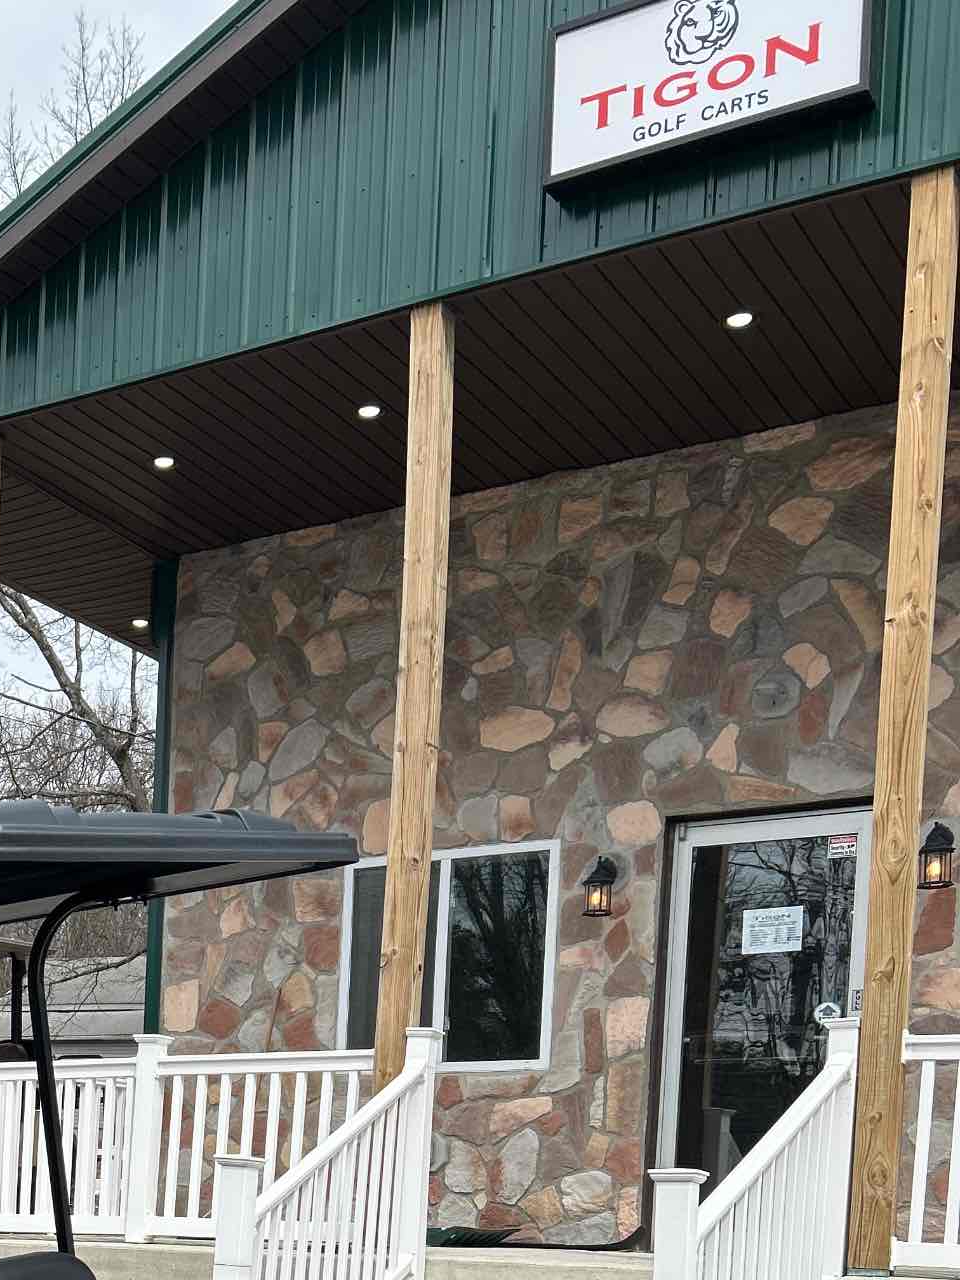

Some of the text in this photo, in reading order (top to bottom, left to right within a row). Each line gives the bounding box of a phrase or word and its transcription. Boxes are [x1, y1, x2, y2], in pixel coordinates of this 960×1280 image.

[580, 22, 822, 130] TIGON
[632, 89, 769, 142] GOLF CARTS
